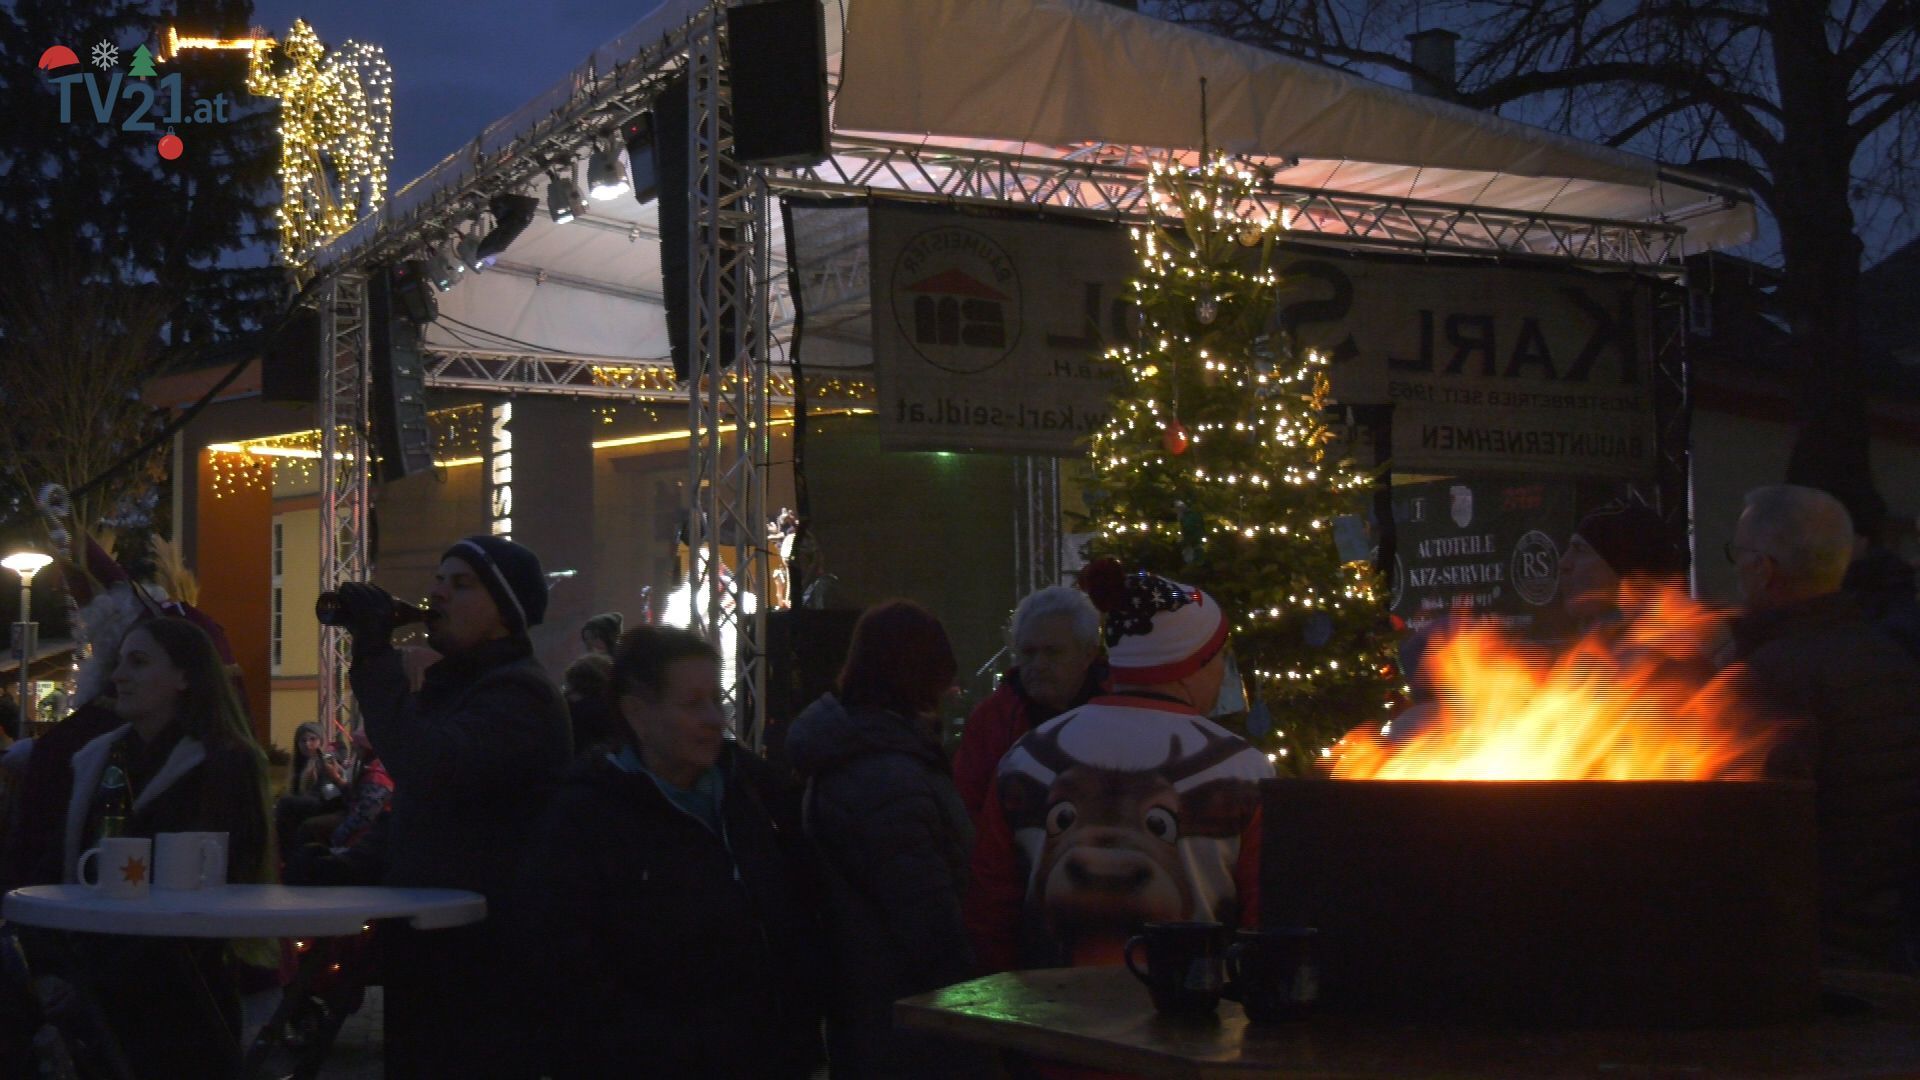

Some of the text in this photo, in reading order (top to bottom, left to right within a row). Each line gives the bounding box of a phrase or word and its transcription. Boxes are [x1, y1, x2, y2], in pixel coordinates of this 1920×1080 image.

[491, 401, 513, 546] MUSI
[1417, 535, 1496, 559] AUTOTEILE
[1408, 562, 1505, 588] KFZ-SERVICE
[1523, 551, 1550, 577] RS
